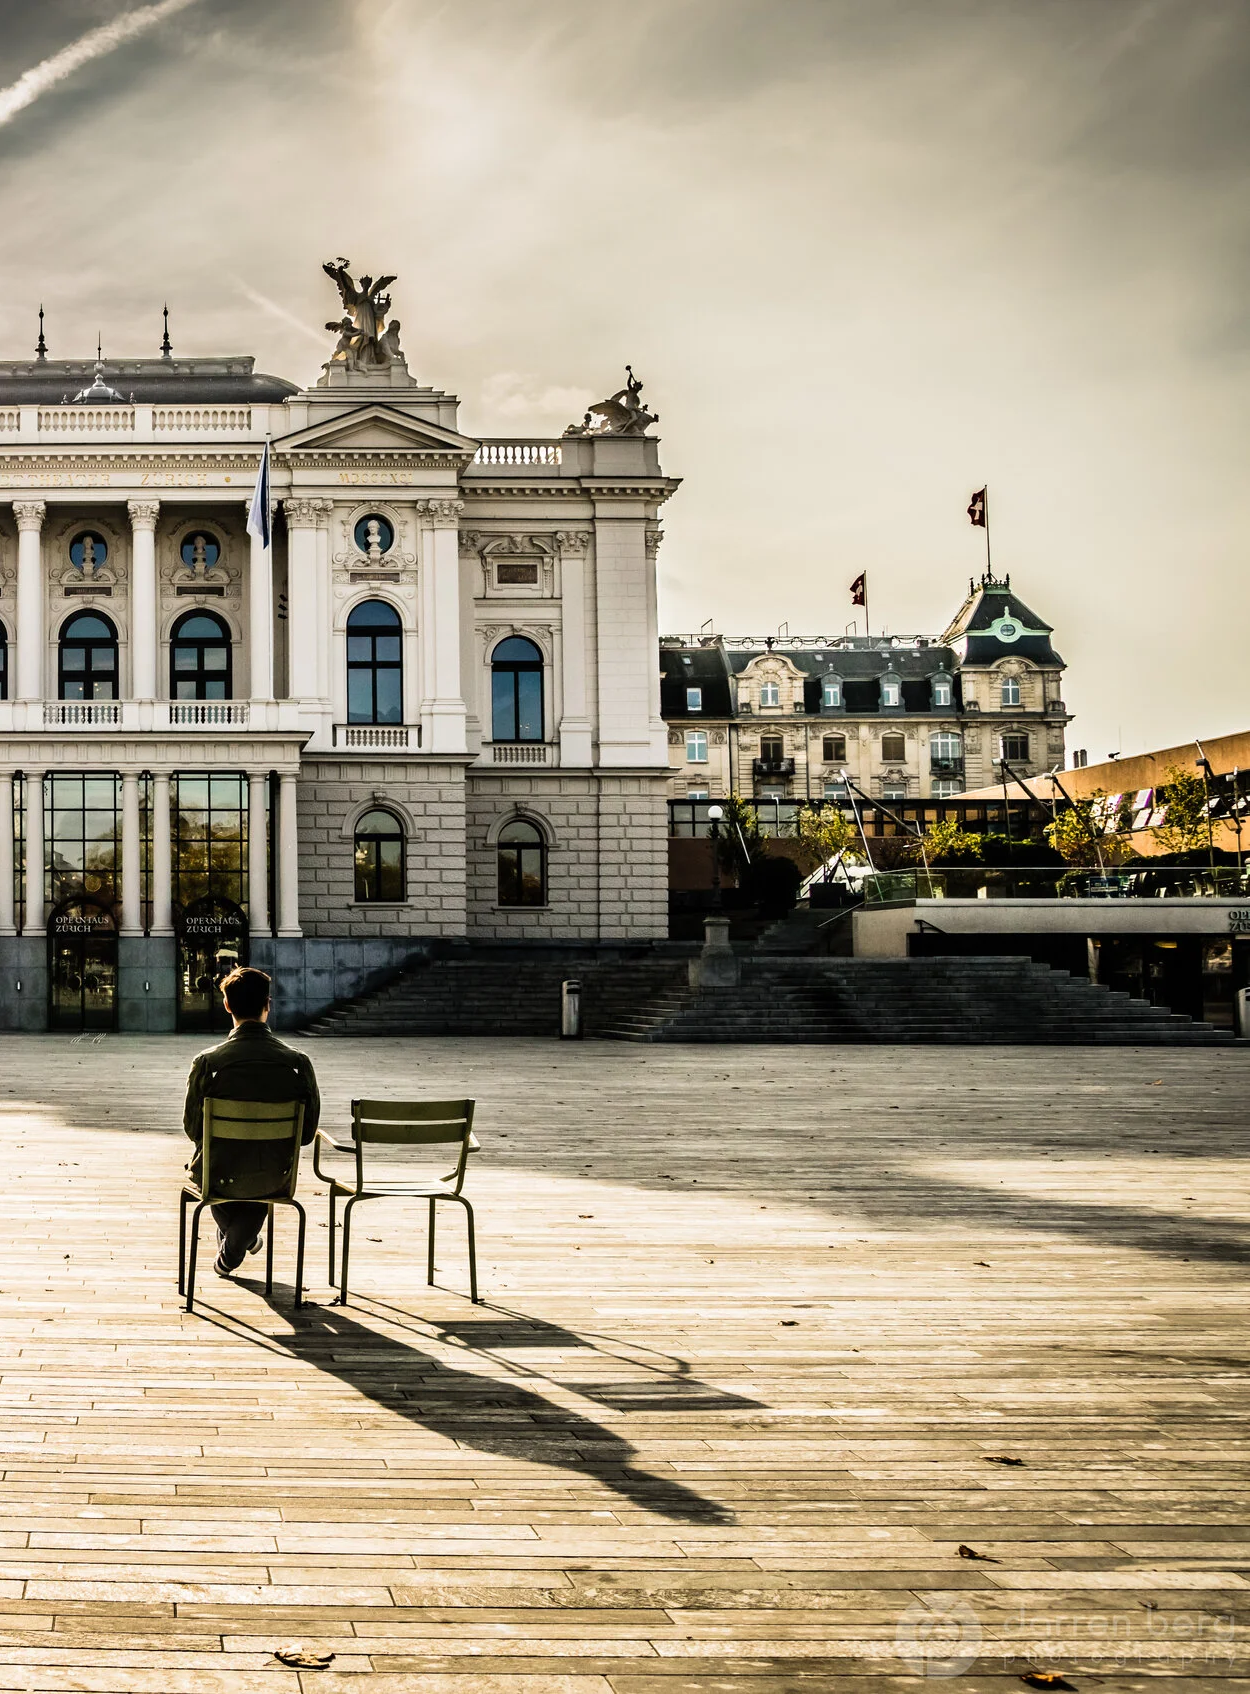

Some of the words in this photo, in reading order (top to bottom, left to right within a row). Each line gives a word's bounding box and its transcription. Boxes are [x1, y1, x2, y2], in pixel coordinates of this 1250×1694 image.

[55, 916, 110, 924] OPERNHAUS
[186, 917, 240, 925] OPERNHAUS
[55, 924, 91, 933] ZÜRICH
